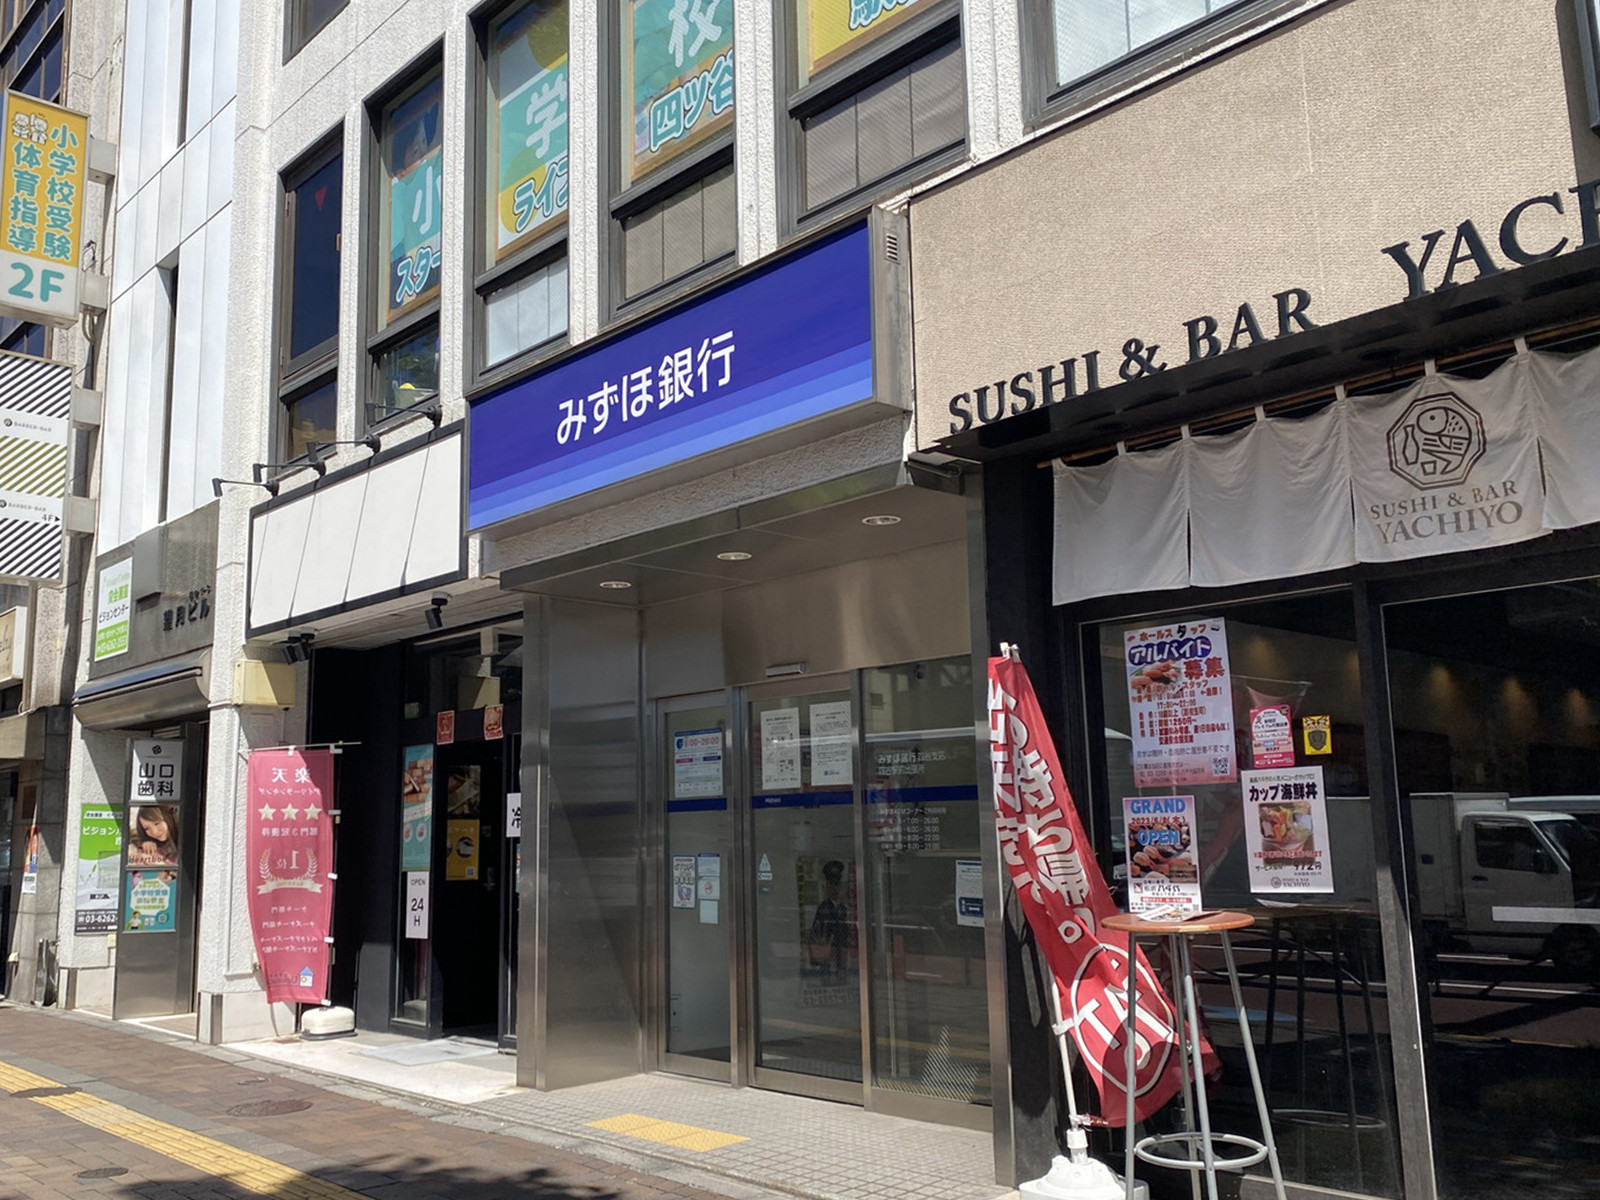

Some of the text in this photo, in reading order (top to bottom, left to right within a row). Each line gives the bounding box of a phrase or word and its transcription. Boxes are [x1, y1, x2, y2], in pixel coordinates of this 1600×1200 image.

[8, 141, 42, 253] 体育指導
[43, 123, 79, 261] 小学校受験
[8, 262, 65, 303] 2F
[948, 349, 1103, 435] SUSHI
[1118, 337, 1168, 382] &
[1183, 287, 1321, 365] BAR
[556, 330, 736, 445] みずほ銀行
[1370, 480, 1518, 520] SUSHI & BAR
[1376, 500, 1523, 545] YACHIYO
[1139, 623, 1207, 642] ホールスタッフ
[1130, 638, 1212, 664] アルバイト
[1183, 656, 1225, 680] 募集
[139, 762, 175, 778] 山口
[137, 780, 175, 797] 歯科
[1249, 782, 1318, 803] カップ海鮮丼
[1131, 798, 1186, 814] GRAND
[1137, 829, 1181, 846] OPEN
[410, 879, 426, 887] OPEN
[411, 898, 424, 912] 24
[413, 916, 421, 927] H
